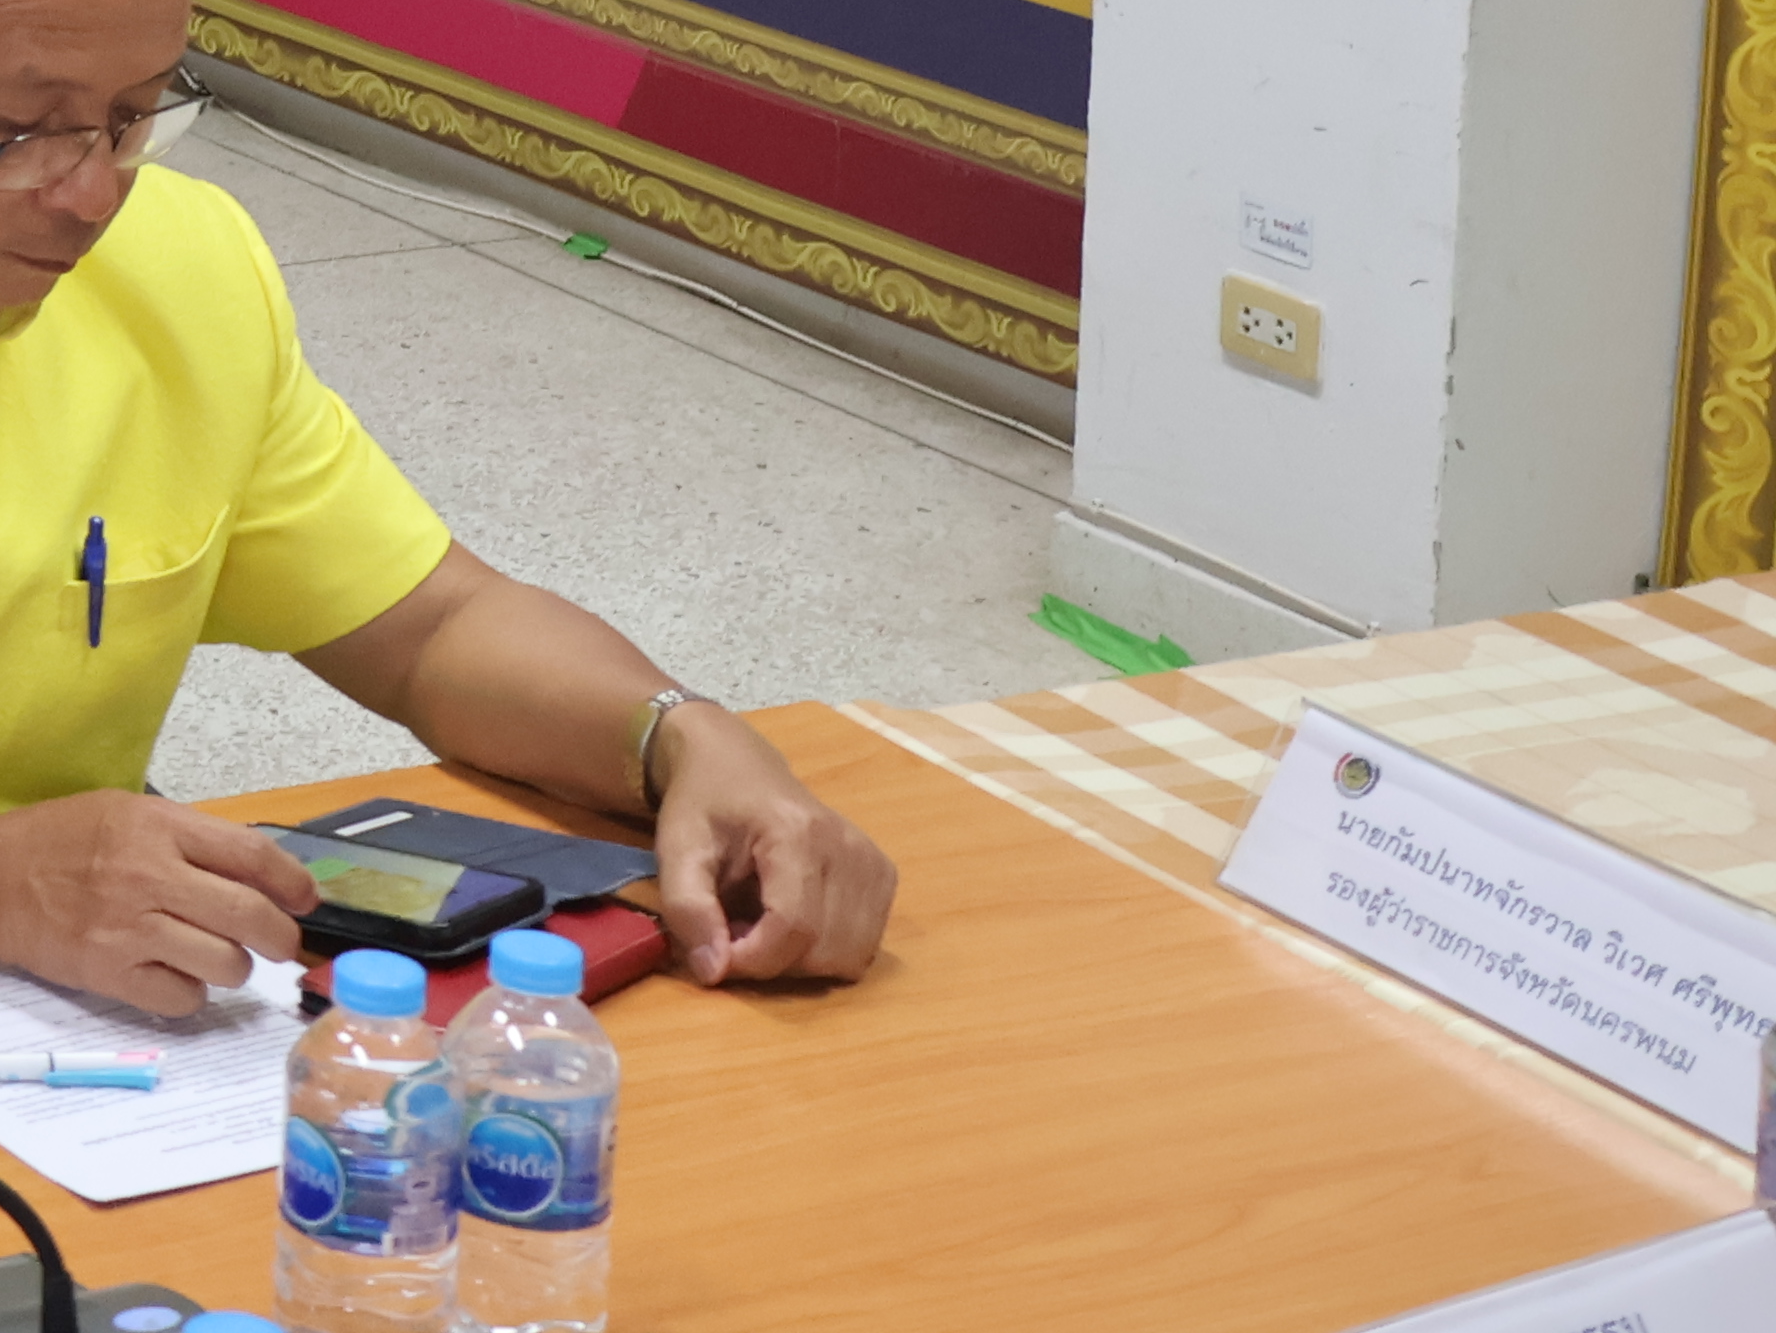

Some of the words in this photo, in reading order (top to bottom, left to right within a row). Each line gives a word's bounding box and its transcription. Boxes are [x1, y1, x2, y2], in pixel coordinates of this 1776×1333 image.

[1336, 807, 1594, 952] นายกัมปนาทจักรวาล
[1325, 869, 1697, 1075] รองผู้ว่าราชการจังหวัดนครพนม
